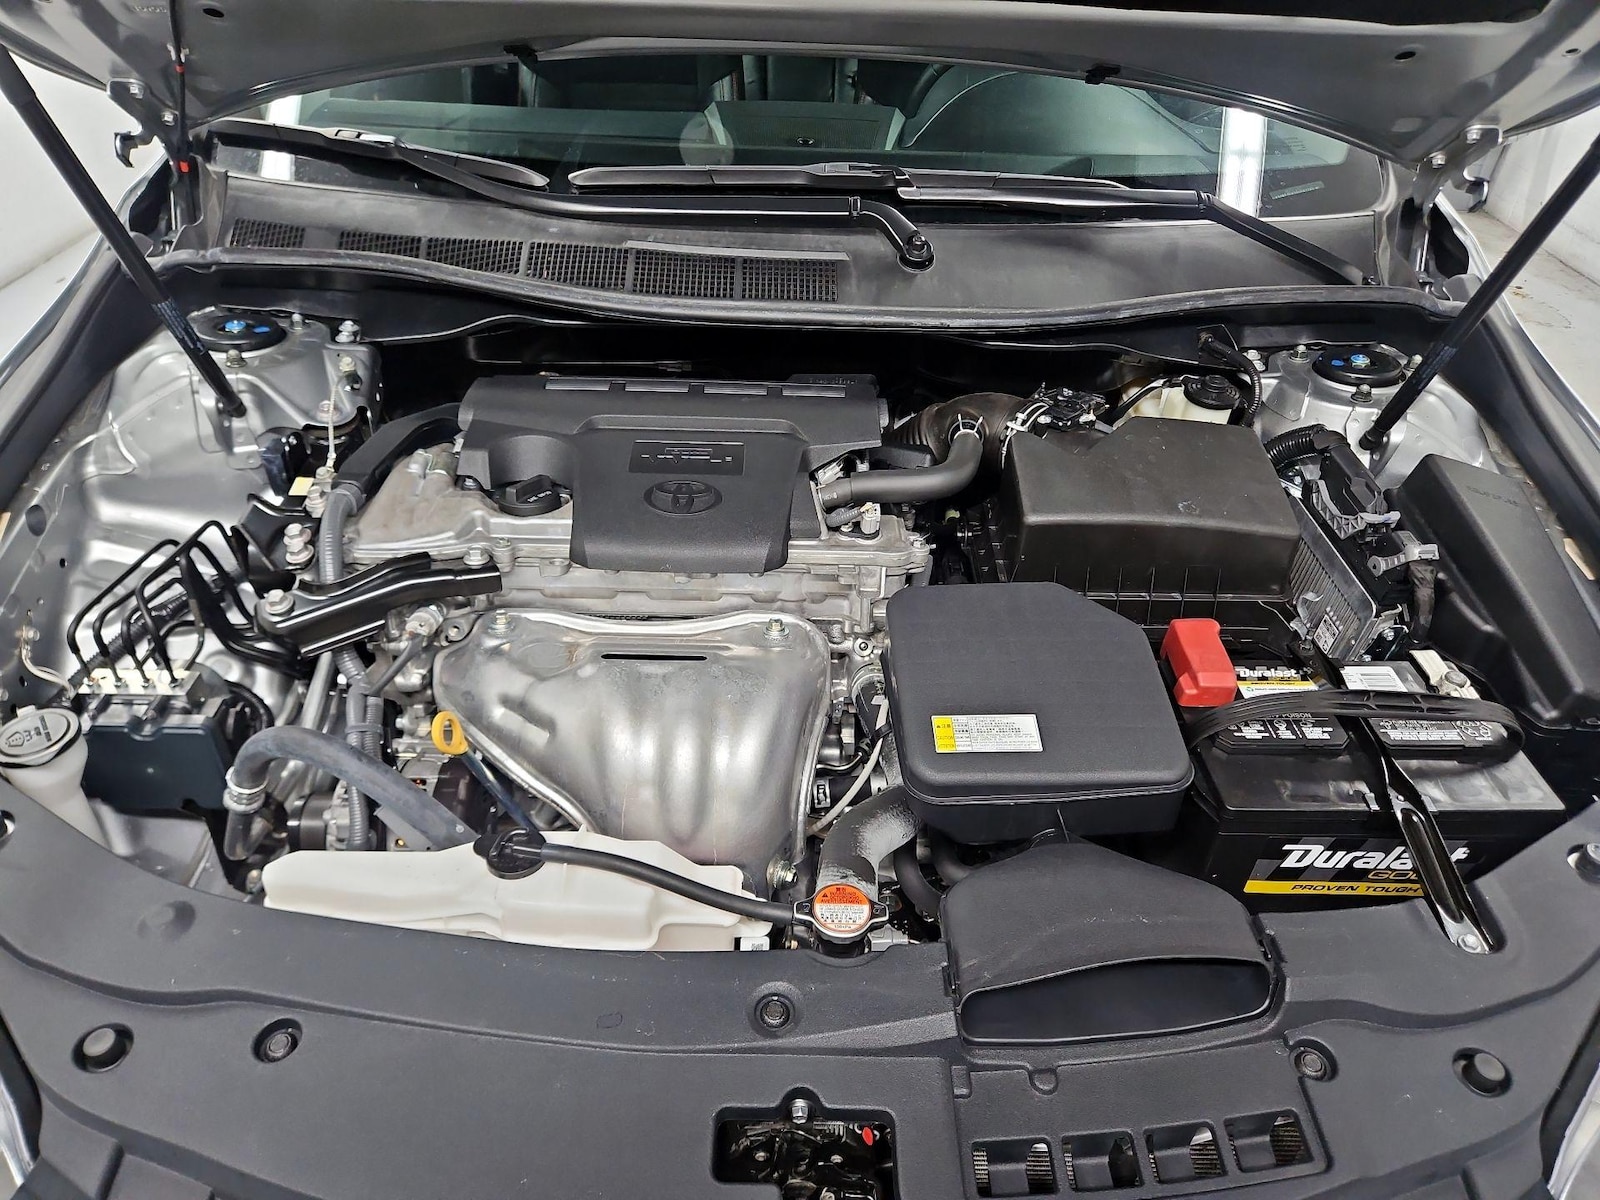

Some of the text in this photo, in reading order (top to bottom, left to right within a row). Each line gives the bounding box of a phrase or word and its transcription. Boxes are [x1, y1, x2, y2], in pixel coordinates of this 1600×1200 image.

[1235, 668, 1297, 677] Duralast
[1280, 845, 1470, 869] Duralat
[1291, 884, 1421, 894] PROVEN TOUGH
